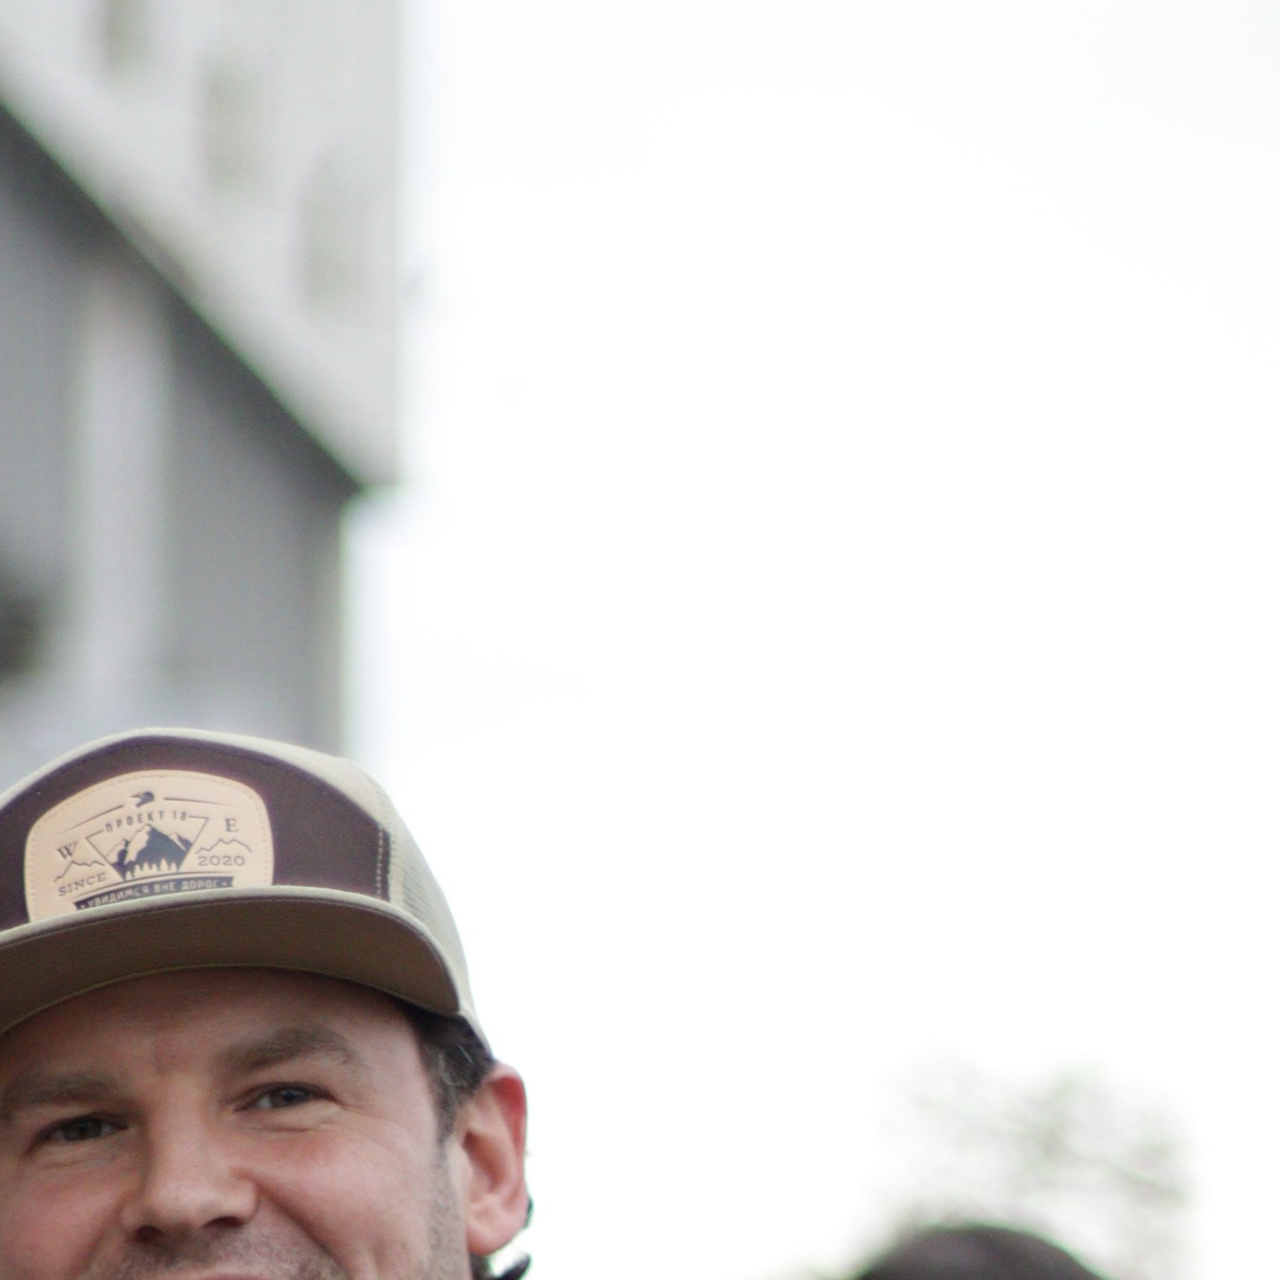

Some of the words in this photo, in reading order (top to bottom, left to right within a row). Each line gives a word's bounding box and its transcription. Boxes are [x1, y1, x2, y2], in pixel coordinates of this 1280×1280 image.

[105, 811, 164, 833] ПРОЕКТ
[224, 818, 239, 833] E
[56, 841, 78, 860] W
[58, 872, 107, 897] SINCE
[197, 855, 245, 867] 2020
[153, 881, 176, 893] ВНЕ
[181, 879, 218, 891] ДОРОГ
